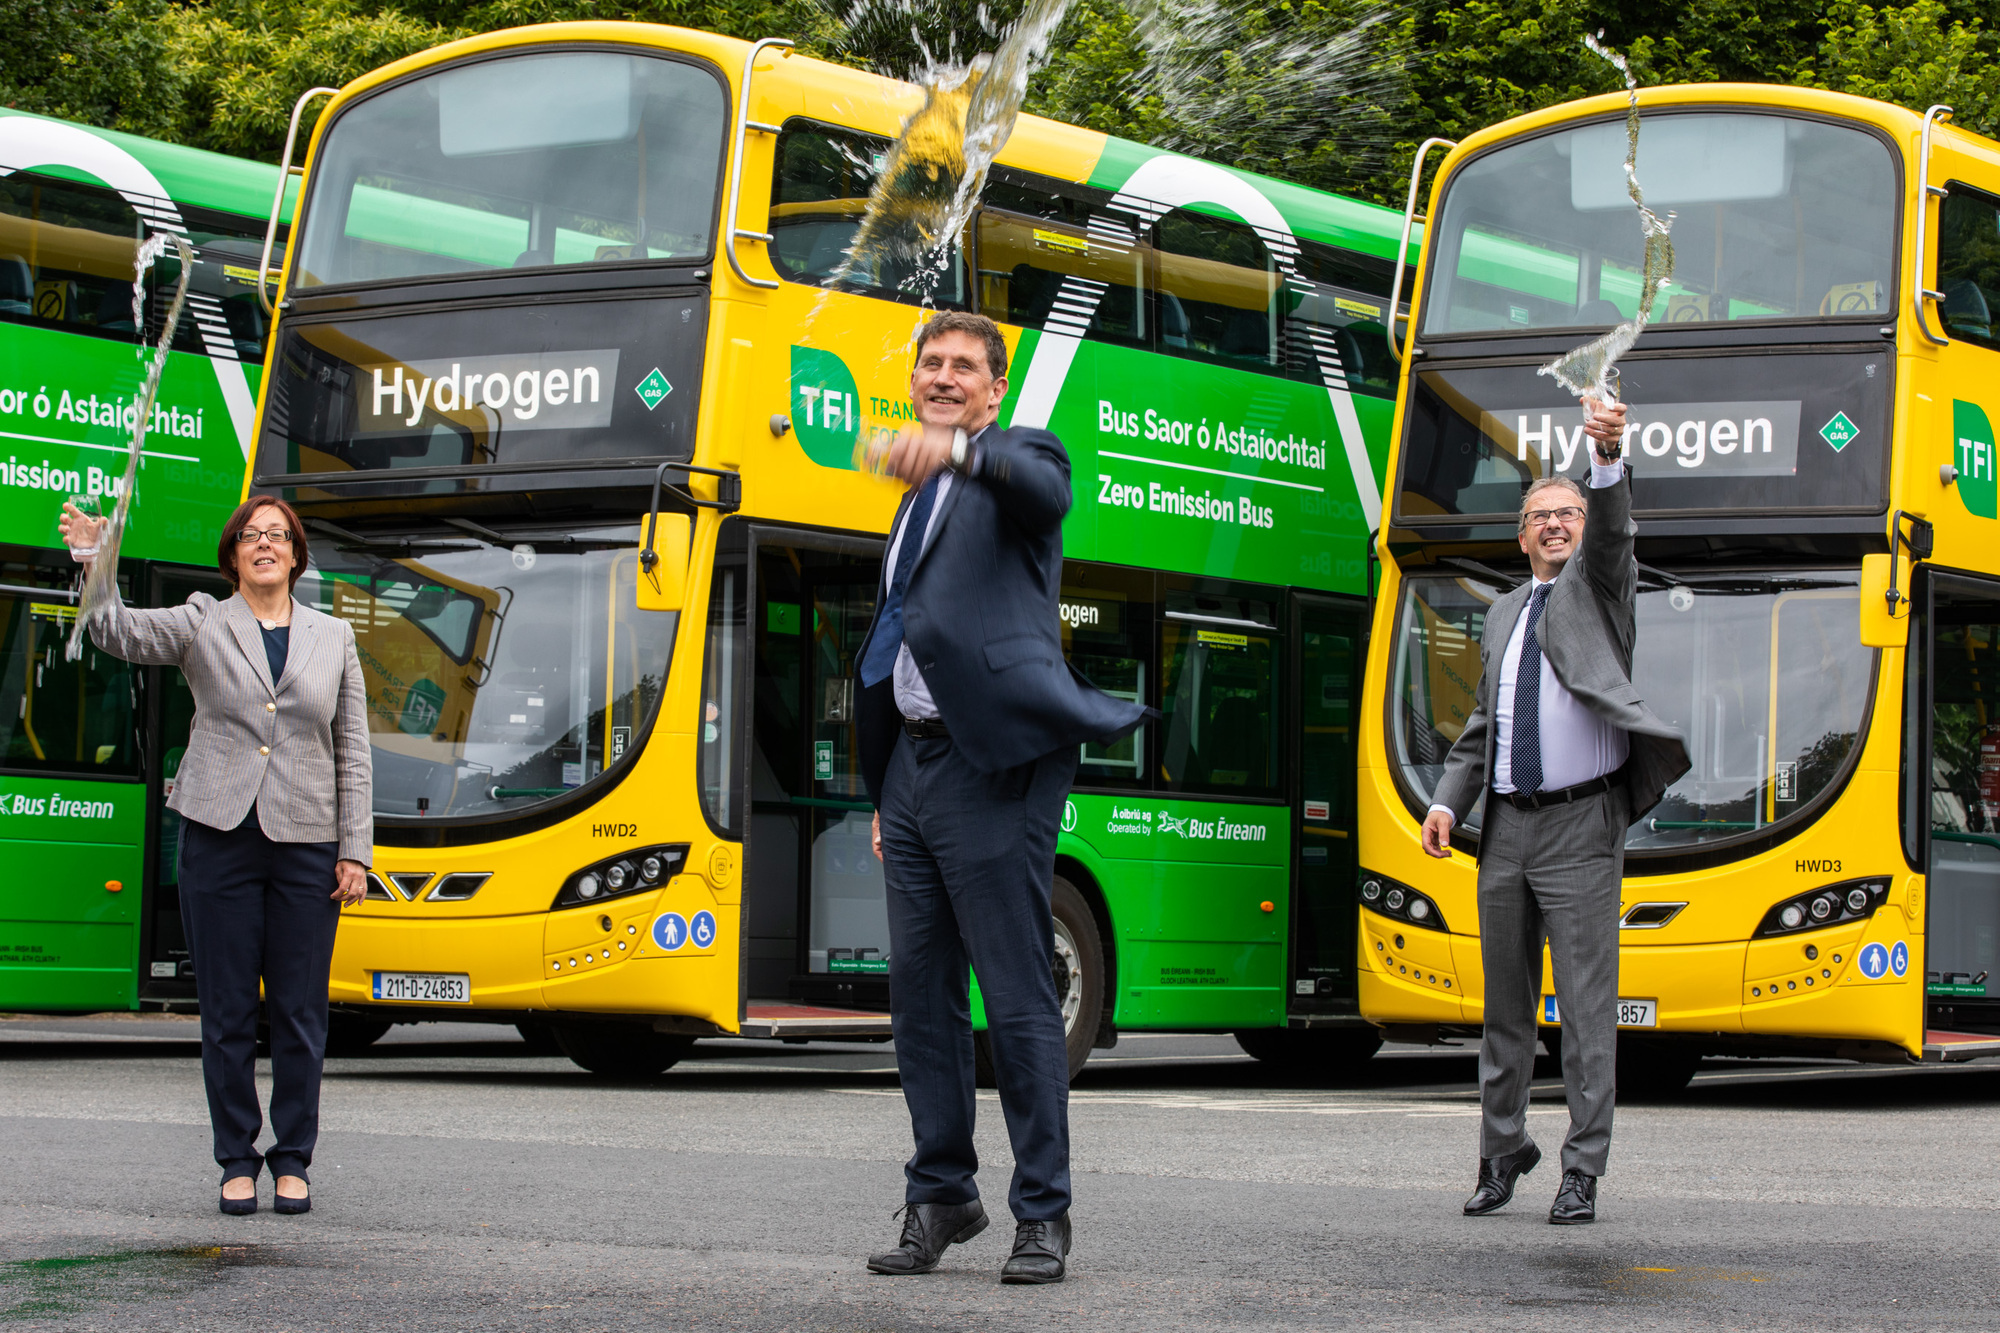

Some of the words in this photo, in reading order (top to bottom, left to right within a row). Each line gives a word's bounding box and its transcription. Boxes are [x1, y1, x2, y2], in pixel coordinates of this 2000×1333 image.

[33, 385, 51, 418] ó
[372, 363, 600, 427] Hydrogen
[644, 388, 663, 398] GAS
[800, 385, 852, 433] TFI
[1099, 399, 1139, 438] Bus
[1144, 408, 1193, 447] Saor
[1197, 417, 1211, 450] ó
[1214, 421, 1326, 470] Astaíochtaí
[1517, 413, 1773, 473] Hyrogen
[1829, 431, 1849, 441] GAS
[1958, 437, 1993, 482] TFI
[86, 466, 125, 499] Bu
[1098, 473, 1145, 509] Zero
[1149, 481, 1234, 523] Emission
[1239, 496, 1274, 529] Bus
[1059, 603, 1099, 628] ogen
[12, 795, 45, 816] Bus
[48, 793, 114, 819] Éireann
[1112, 805, 1119, 820] Á
[1142, 810, 1152, 823] ag
[592, 823, 638, 838] HWD2
[1107, 821, 1141, 835] Operated
[1142, 823, 1152, 836] by
[1189, 818, 1214, 839] Bus
[1216, 816, 1267, 842] Éireann
[1795, 859, 1842, 873] HWD3
[1161, 967, 1170, 975] BUS
[387, 978, 463, 999] 211-D-24853
